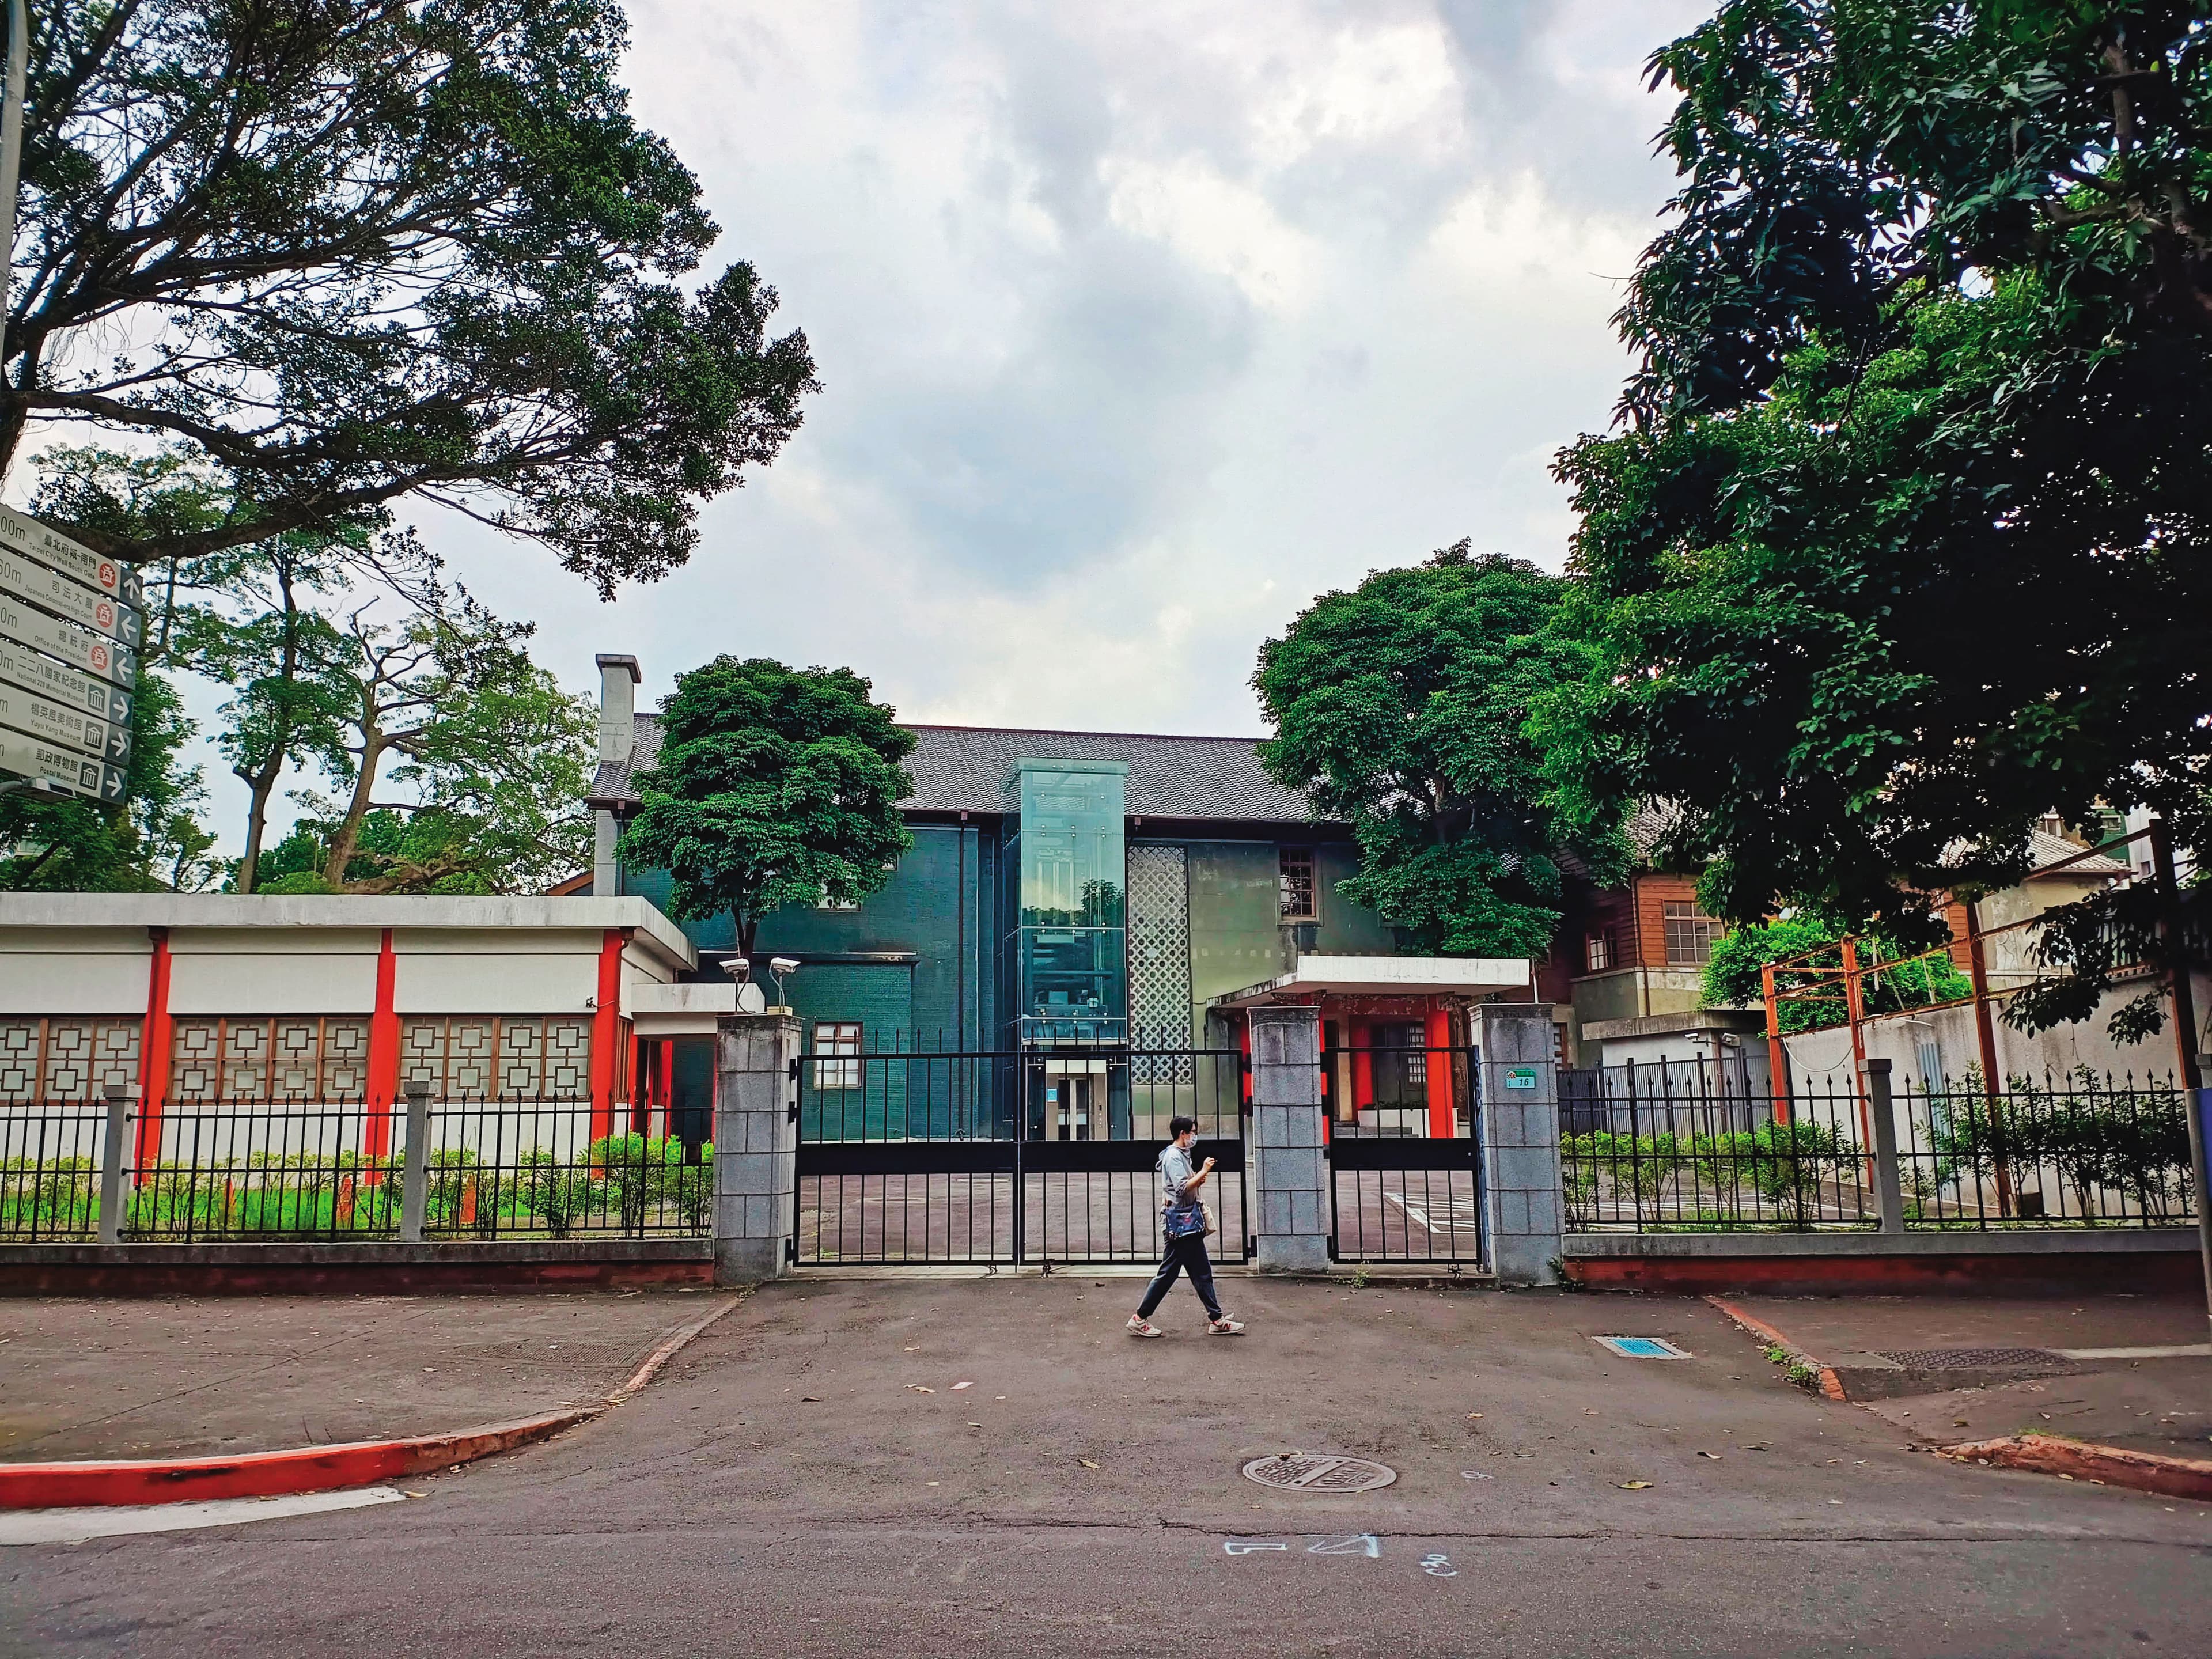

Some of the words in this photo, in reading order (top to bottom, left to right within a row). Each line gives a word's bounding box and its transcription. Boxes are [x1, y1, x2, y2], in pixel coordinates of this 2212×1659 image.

[29, 542, 45, 555] Taipei
[46, 550, 56, 562] City
[57, 555, 68, 566] Wall
[69, 562, 83, 574] South
[84, 570, 95, 579] Gate
[35, 635, 50, 646] Office
[65, 649, 87, 663] President
[17, 672, 36, 684] National
[37, 679, 45, 688] 228
[46, 683, 66, 696] Memorial
[67, 692, 85, 703] Museum
[31, 718, 44, 729] Yuyu
[45, 724, 59, 736] Yang
[59, 729, 81, 742] Museum
[40, 766, 56, 777] Postal
[56, 772, 77, 783] Museum
